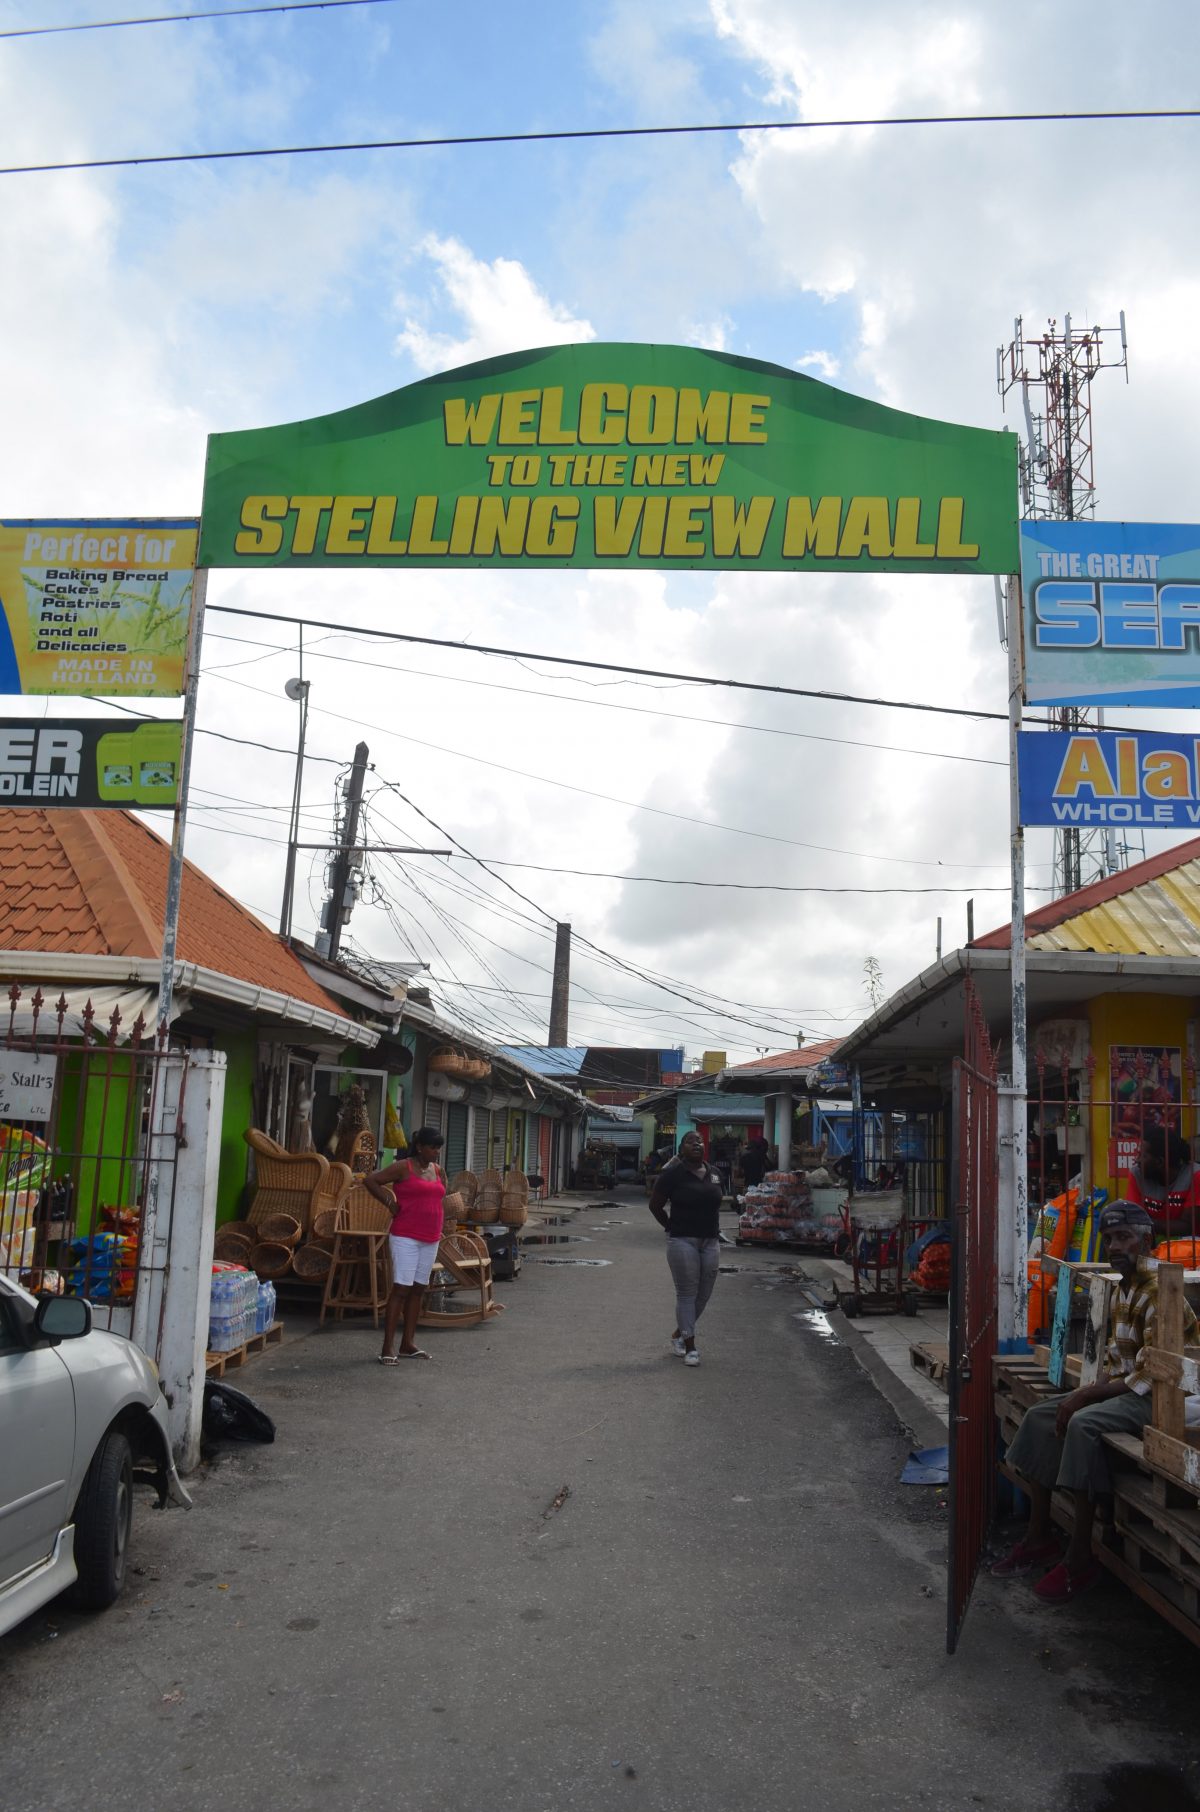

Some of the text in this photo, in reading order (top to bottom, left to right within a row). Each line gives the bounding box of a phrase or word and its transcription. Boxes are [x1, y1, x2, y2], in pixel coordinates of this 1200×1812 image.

[443, 383, 771, 447] WELCOME
[486, 454, 726, 487] TO THE NEW
[233, 495, 980, 561] STELLING VIEW MALL
[23, 532, 177, 564] Perfect for
[1036, 552, 1160, 579] THE GREAT
[45, 569, 169, 583] Baking Bread
[43, 583, 99, 595] Cakes
[42, 598, 121, 609] Pastries
[40, 611, 78, 623] Roti
[38, 626, 99, 637] and all
[36, 640, 128, 652] Delicacies
[57, 658, 153, 672] MADE IN
[51, 671, 157, 685] HOLLAND
[1052, 736, 1200, 801] Ala
[0, 774, 79, 798] OLEIN
[1051, 802, 1175, 822] WHOLE
